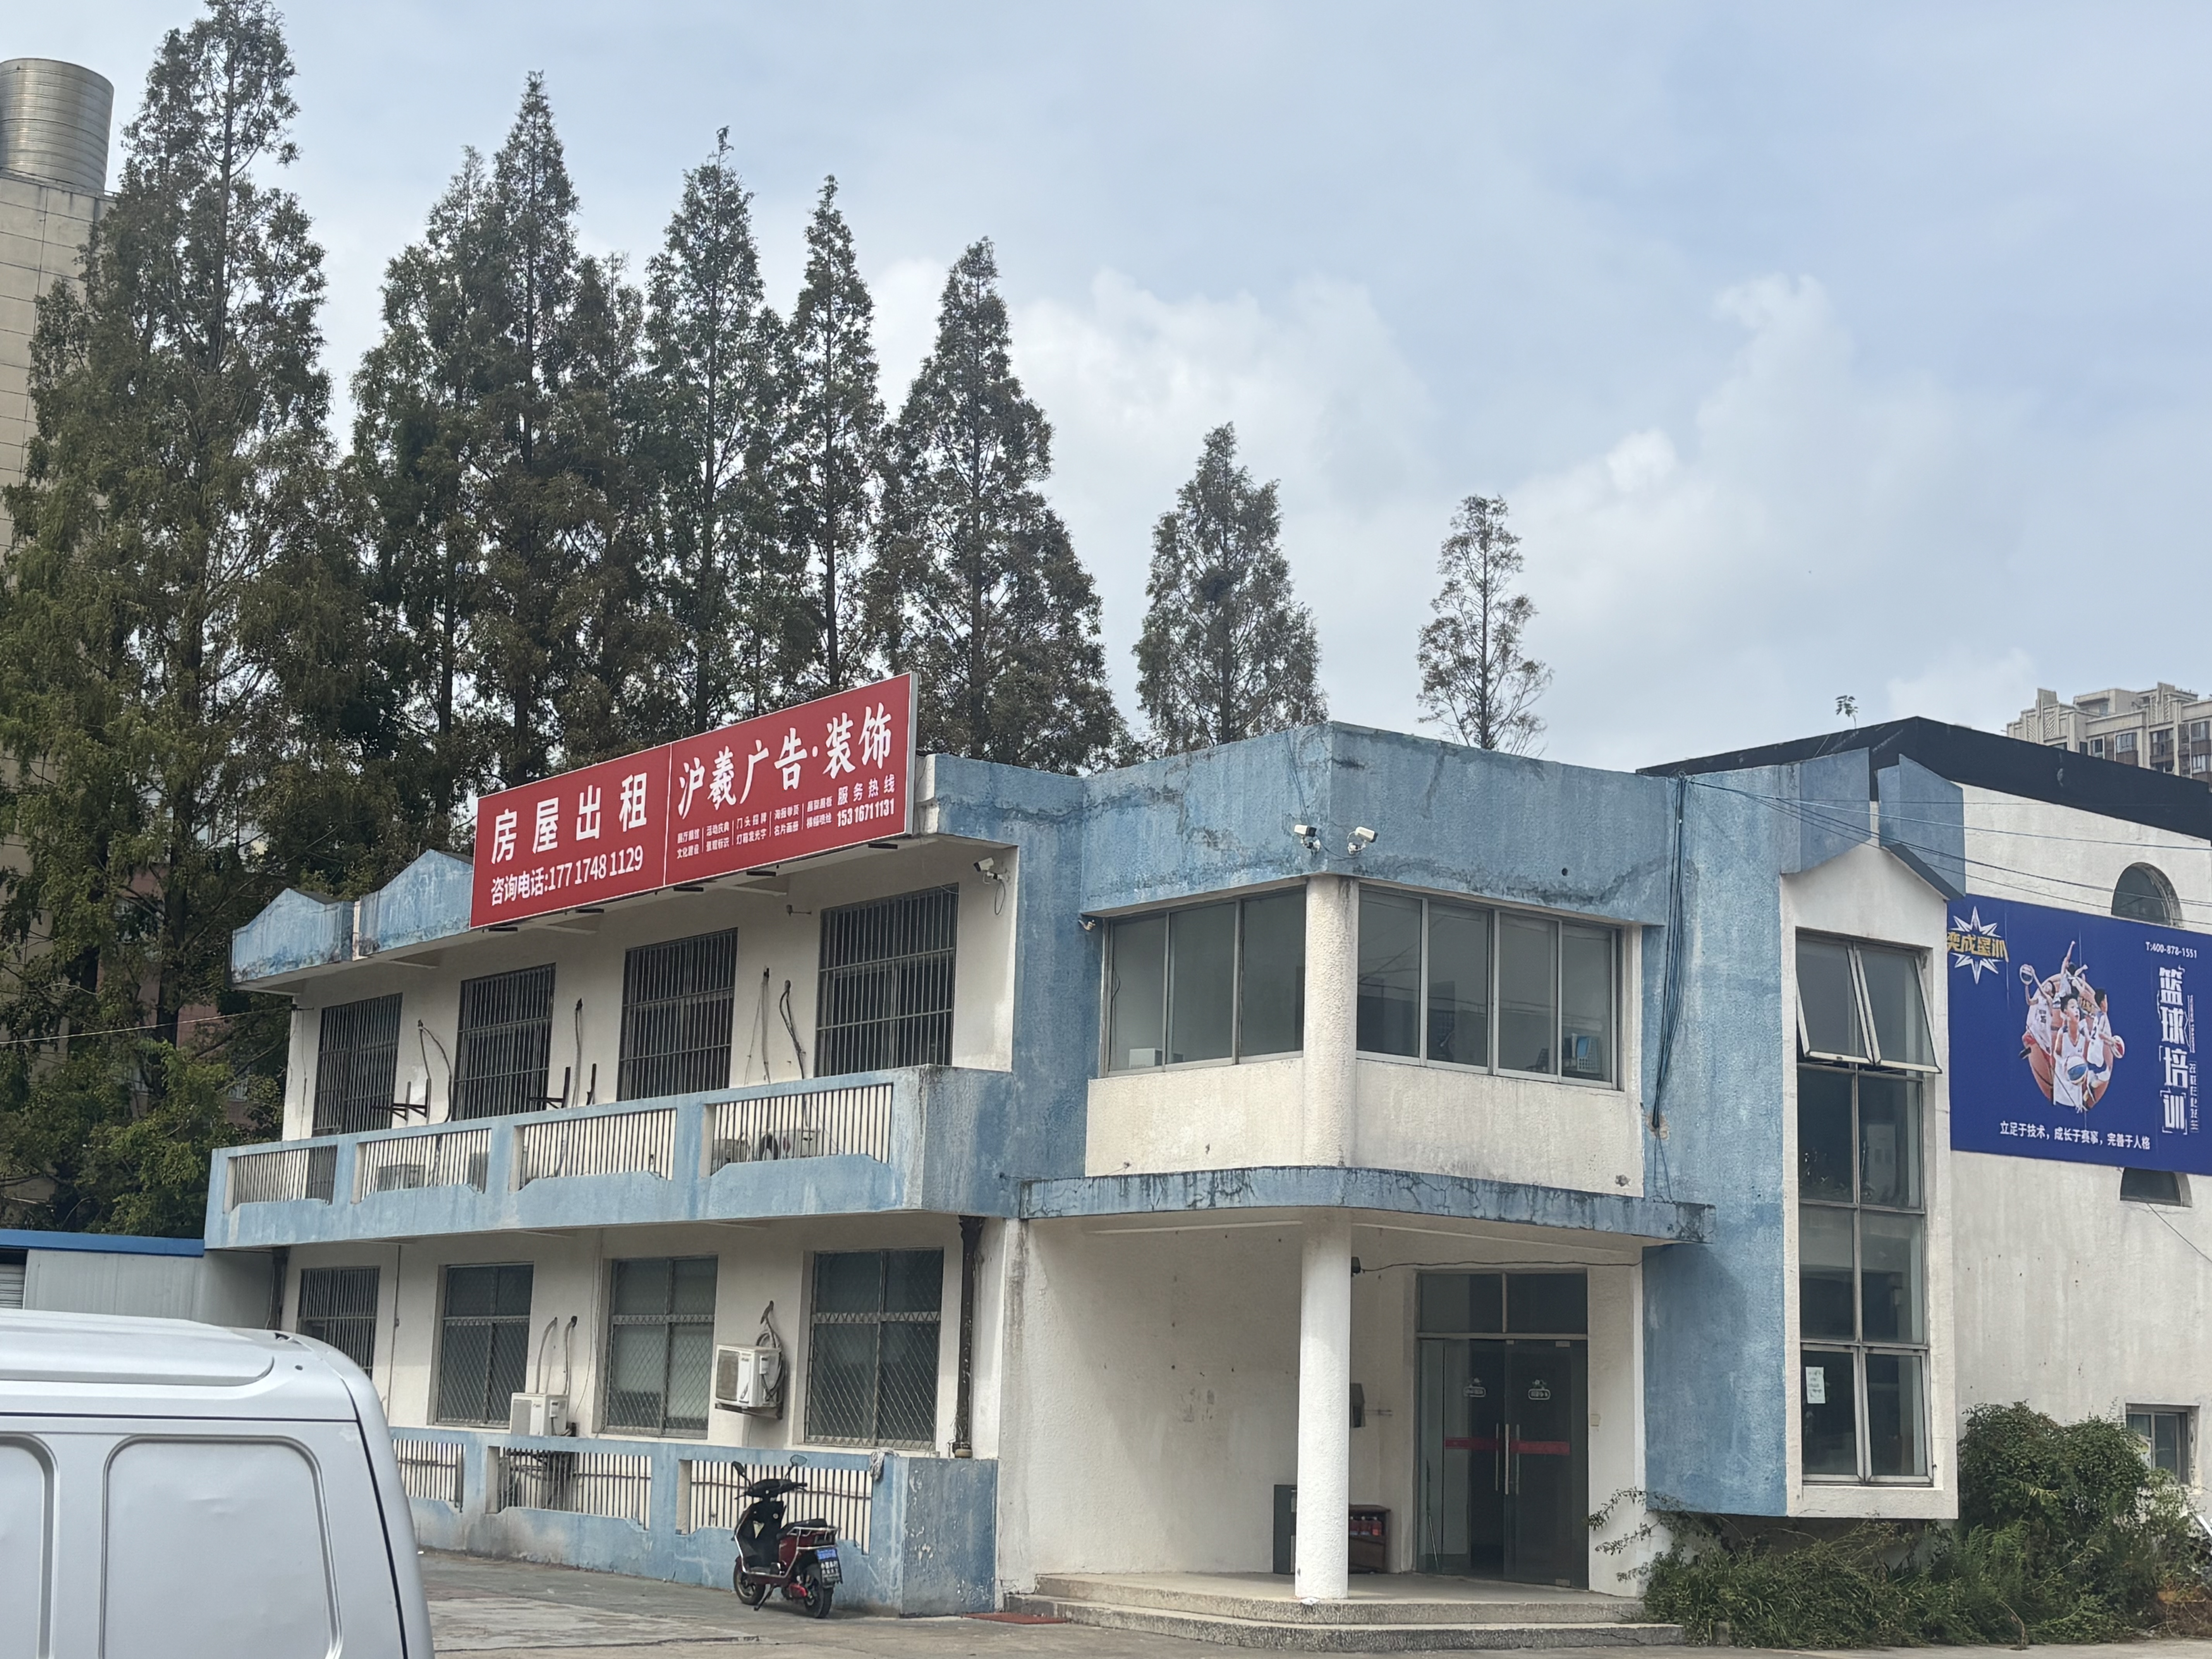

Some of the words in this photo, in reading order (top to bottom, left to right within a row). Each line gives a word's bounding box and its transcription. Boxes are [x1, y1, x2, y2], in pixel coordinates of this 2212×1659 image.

[838, 774, 895, 805] 服务热线
[491, 773, 647, 864] 房屋出租
[837, 808, 852, 827] 153
[575, 854, 606, 884] 1748
[609, 845, 643, 876] 1129
[2159, 967, 2188, 1130] 篮球培训
